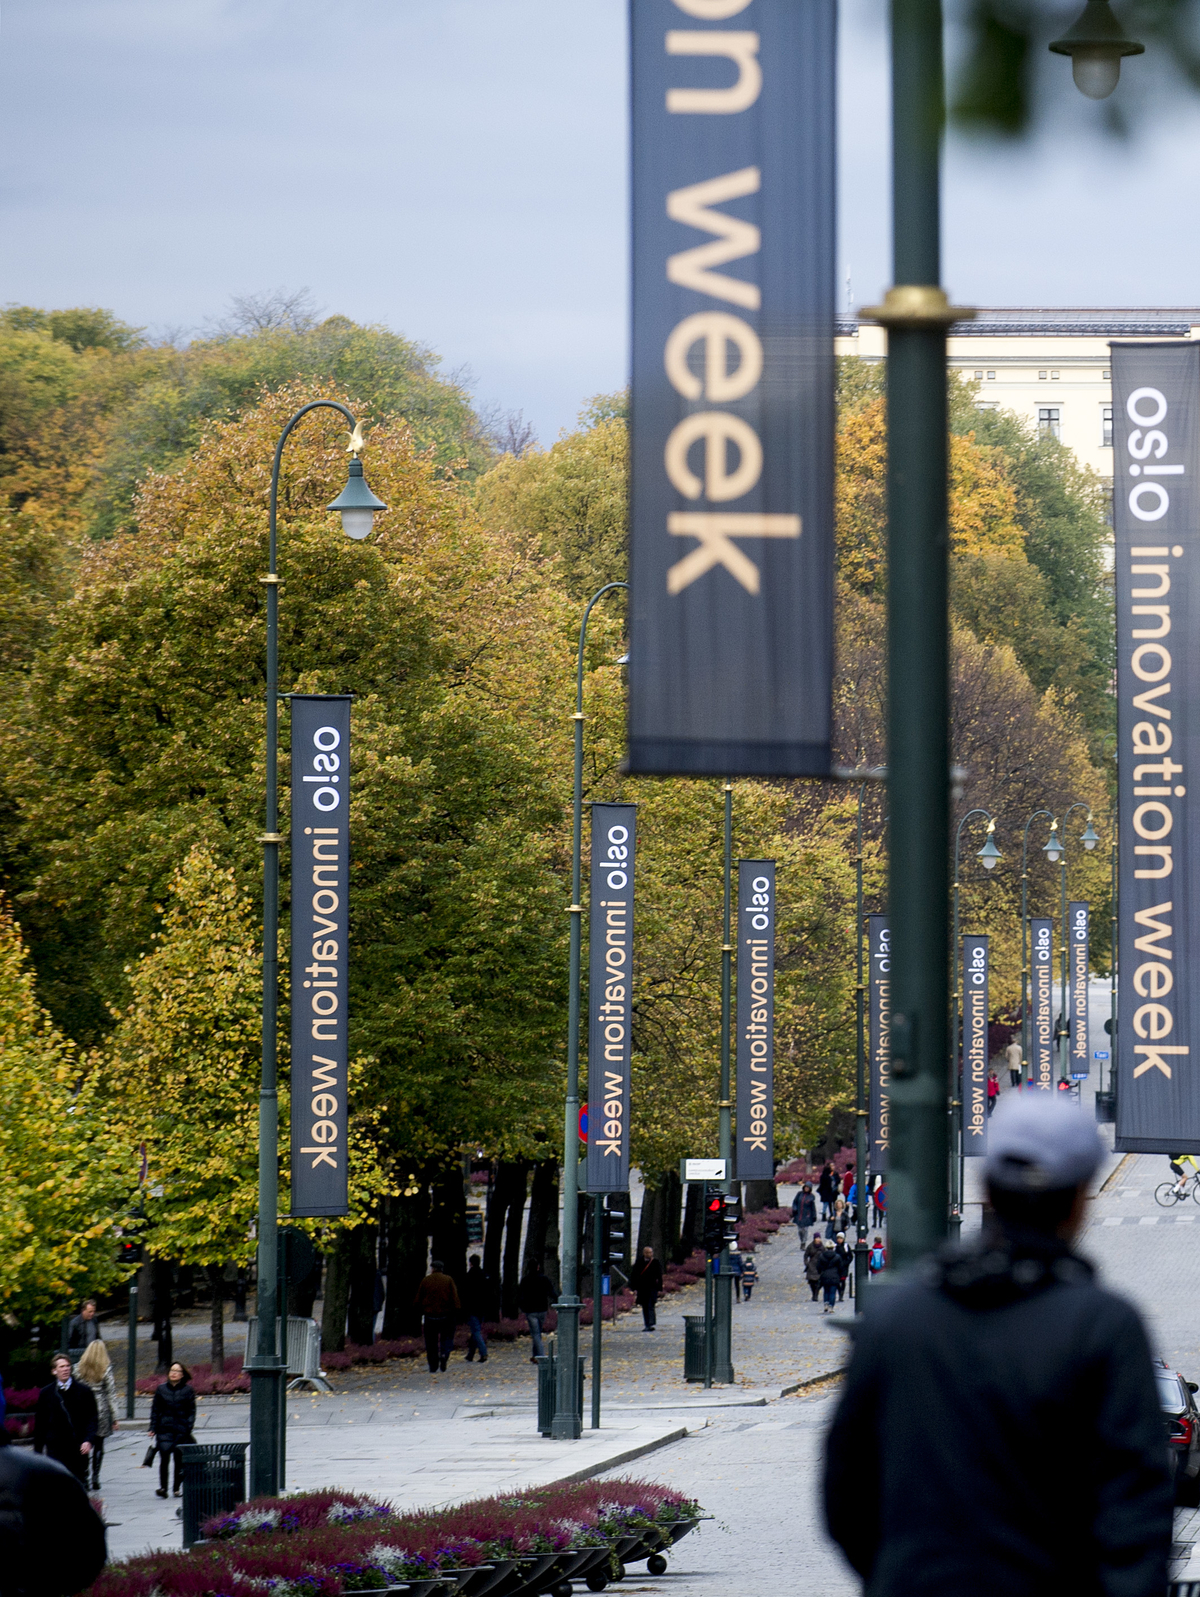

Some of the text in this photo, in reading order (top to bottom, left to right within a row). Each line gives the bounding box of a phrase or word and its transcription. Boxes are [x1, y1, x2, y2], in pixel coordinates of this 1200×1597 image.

[664, 167, 801, 592] week
[1130, 544, 1186, 879] innovation
[1132, 901, 1190, 1079] week
